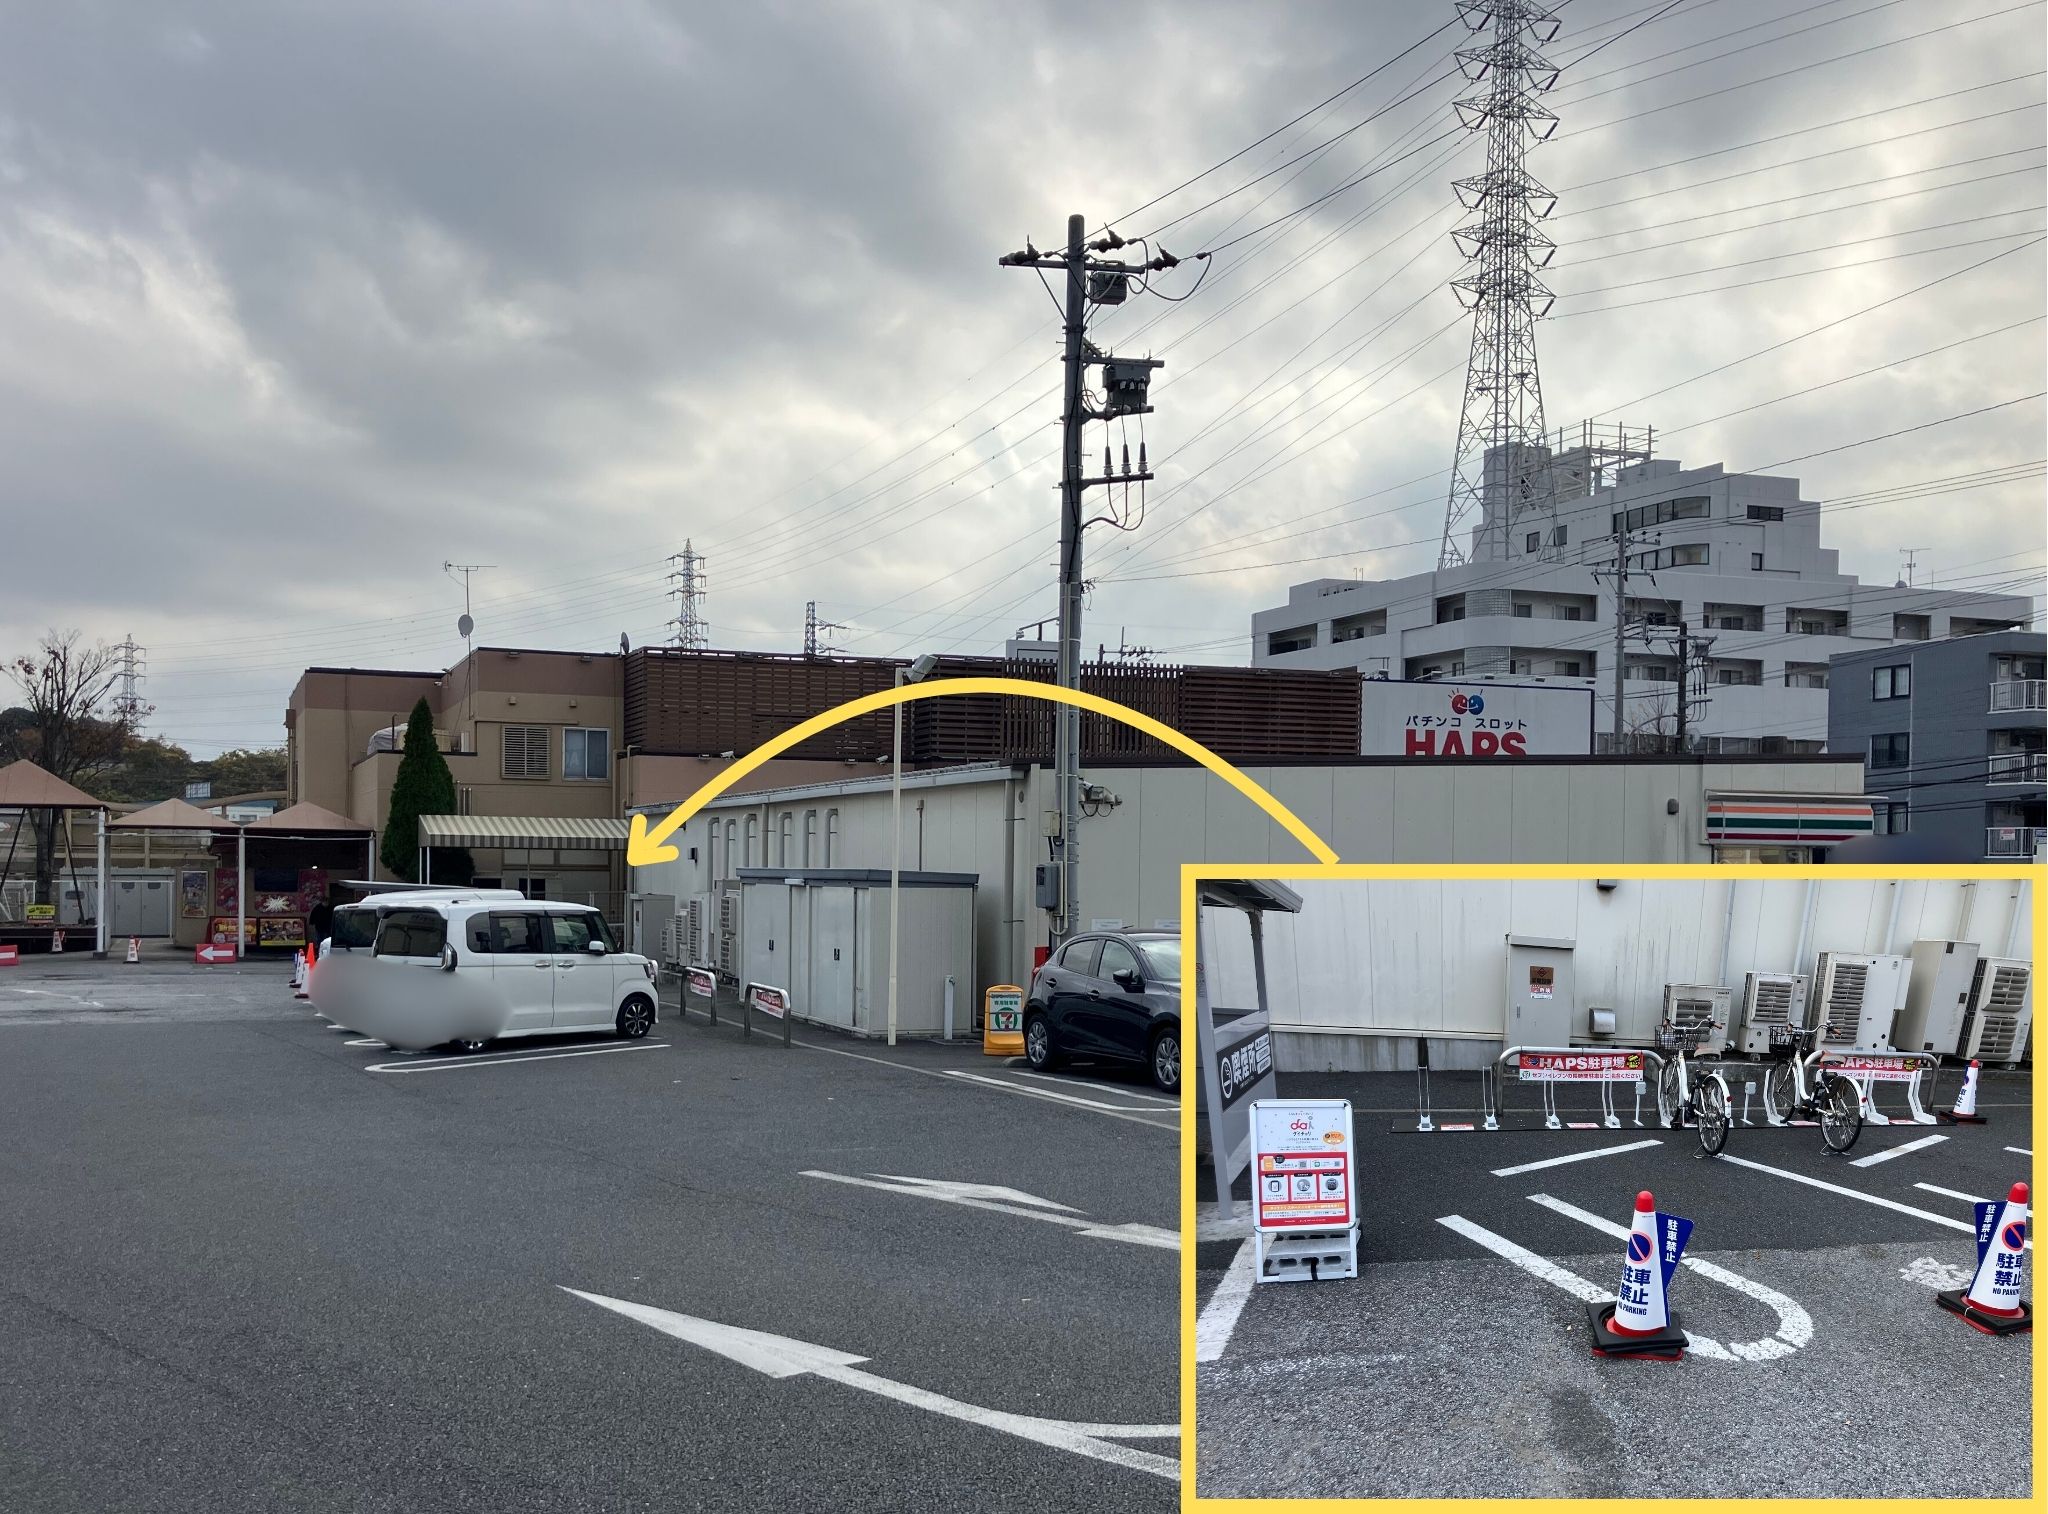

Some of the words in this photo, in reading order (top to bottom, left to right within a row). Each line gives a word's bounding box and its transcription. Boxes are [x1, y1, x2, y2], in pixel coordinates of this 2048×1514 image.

[1406, 715, 1461, 727] パチンコ
[1475, 718, 1527, 730] スロット
[1405, 729, 1527, 756] HAPS
[1231, 1041, 1257, 1085] 喫煙所
[1540, 1056, 1625, 1070] HAPS駐車場
[1840, 1057, 1904, 1070] APS駐車場
[1979, 1204, 1996, 1242] 駐車禁止
[1665, 1219, 1678, 1263] 駐車禁止
[1623, 1264, 1651, 1286] 駐車
[1620, 1282, 1648, 1305] 禁止
[1623, 1303, 1647, 1316] PARKING
